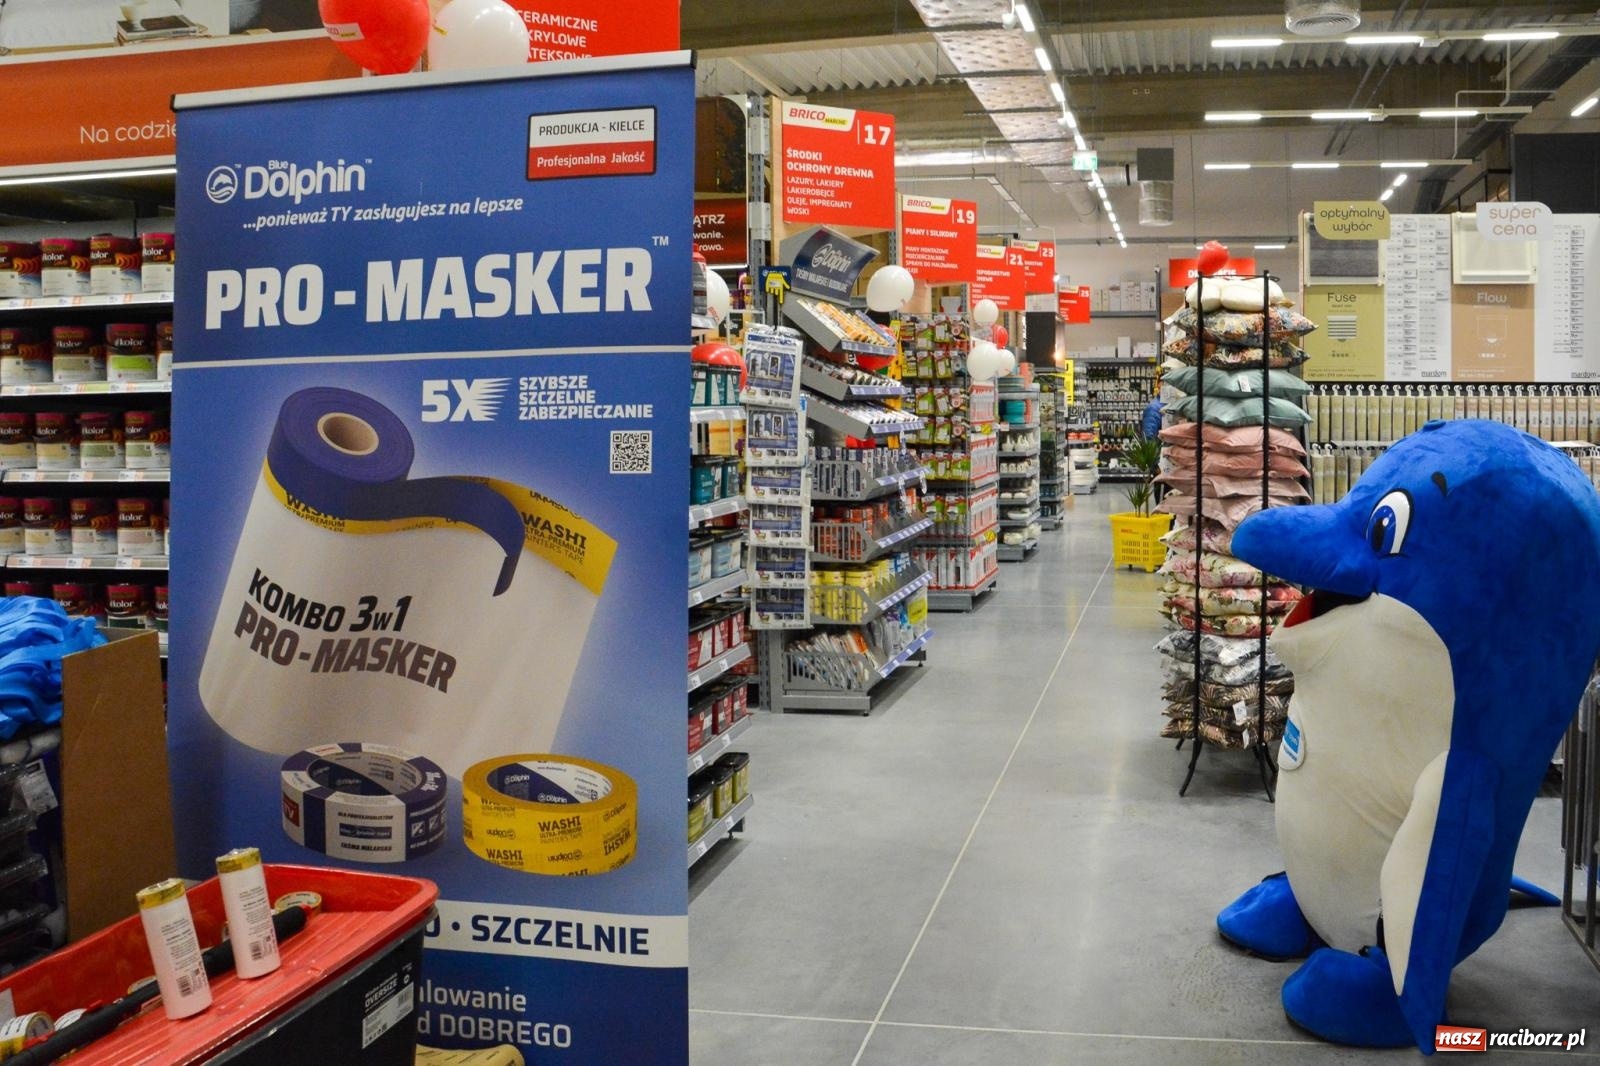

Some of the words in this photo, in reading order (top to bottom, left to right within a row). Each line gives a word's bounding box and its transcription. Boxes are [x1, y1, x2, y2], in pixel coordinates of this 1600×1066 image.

[517, 10, 598, 32] ERAMICZNE
[789, 107, 826, 121] BRICO
[80, 125, 109, 144] Na
[538, 121, 600, 136] PRODUKCJA
[608, 119, 646, 132] KIELCE
[864, 124, 892, 146] 17
[536, 153, 606, 169] Profesjonalna
[610, 151, 646, 165] Jakość
[786, 146, 823, 161] ŚRODKI
[268, 159, 289, 170] Blue
[786, 161, 833, 174] OCHRONY
[834, 166, 875, 179] DREWNA
[244, 160, 366, 205] Dolphin
[816, 178, 845, 189] LAKIERY
[331, 206, 352, 221] TY
[353, 201, 446, 223] zasługujesz
[448, 201, 470, 215] na
[472, 196, 524, 217] lepsze
[786, 207, 810, 216] WOSKI
[956, 208, 975, 225] 19
[1320, 205, 1386, 221] optymalny
[1489, 206, 1542, 223] super
[1332, 220, 1374, 234] wybór
[1492, 223, 1538, 236] cena
[1009, 253, 1024, 266] 21
[1042, 247, 1055, 258] 23
[205, 263, 325, 331] PRO
[365, 247, 653, 323] MASKER
[1327, 292, 1357, 303] Fuse
[1476, 291, 1508, 304] Flow
[518, 375, 589, 391] SZYBSZE
[420, 376, 513, 423] 5X
[518, 389, 597, 406] SZCZELNE
[518, 404, 654, 421] ZABEZPIECZANIE
[521, 511, 587, 550] WASHI
[247, 567, 346, 633] KOMBO
[233, 600, 458, 694] PRO-MASKER
[537, 815, 582, 832] WASHI
[486, 848, 524, 861] WASHI
[470, 913, 650, 956] SZCZELNIE
[439, 1013, 572, 1048] DOBREGO
